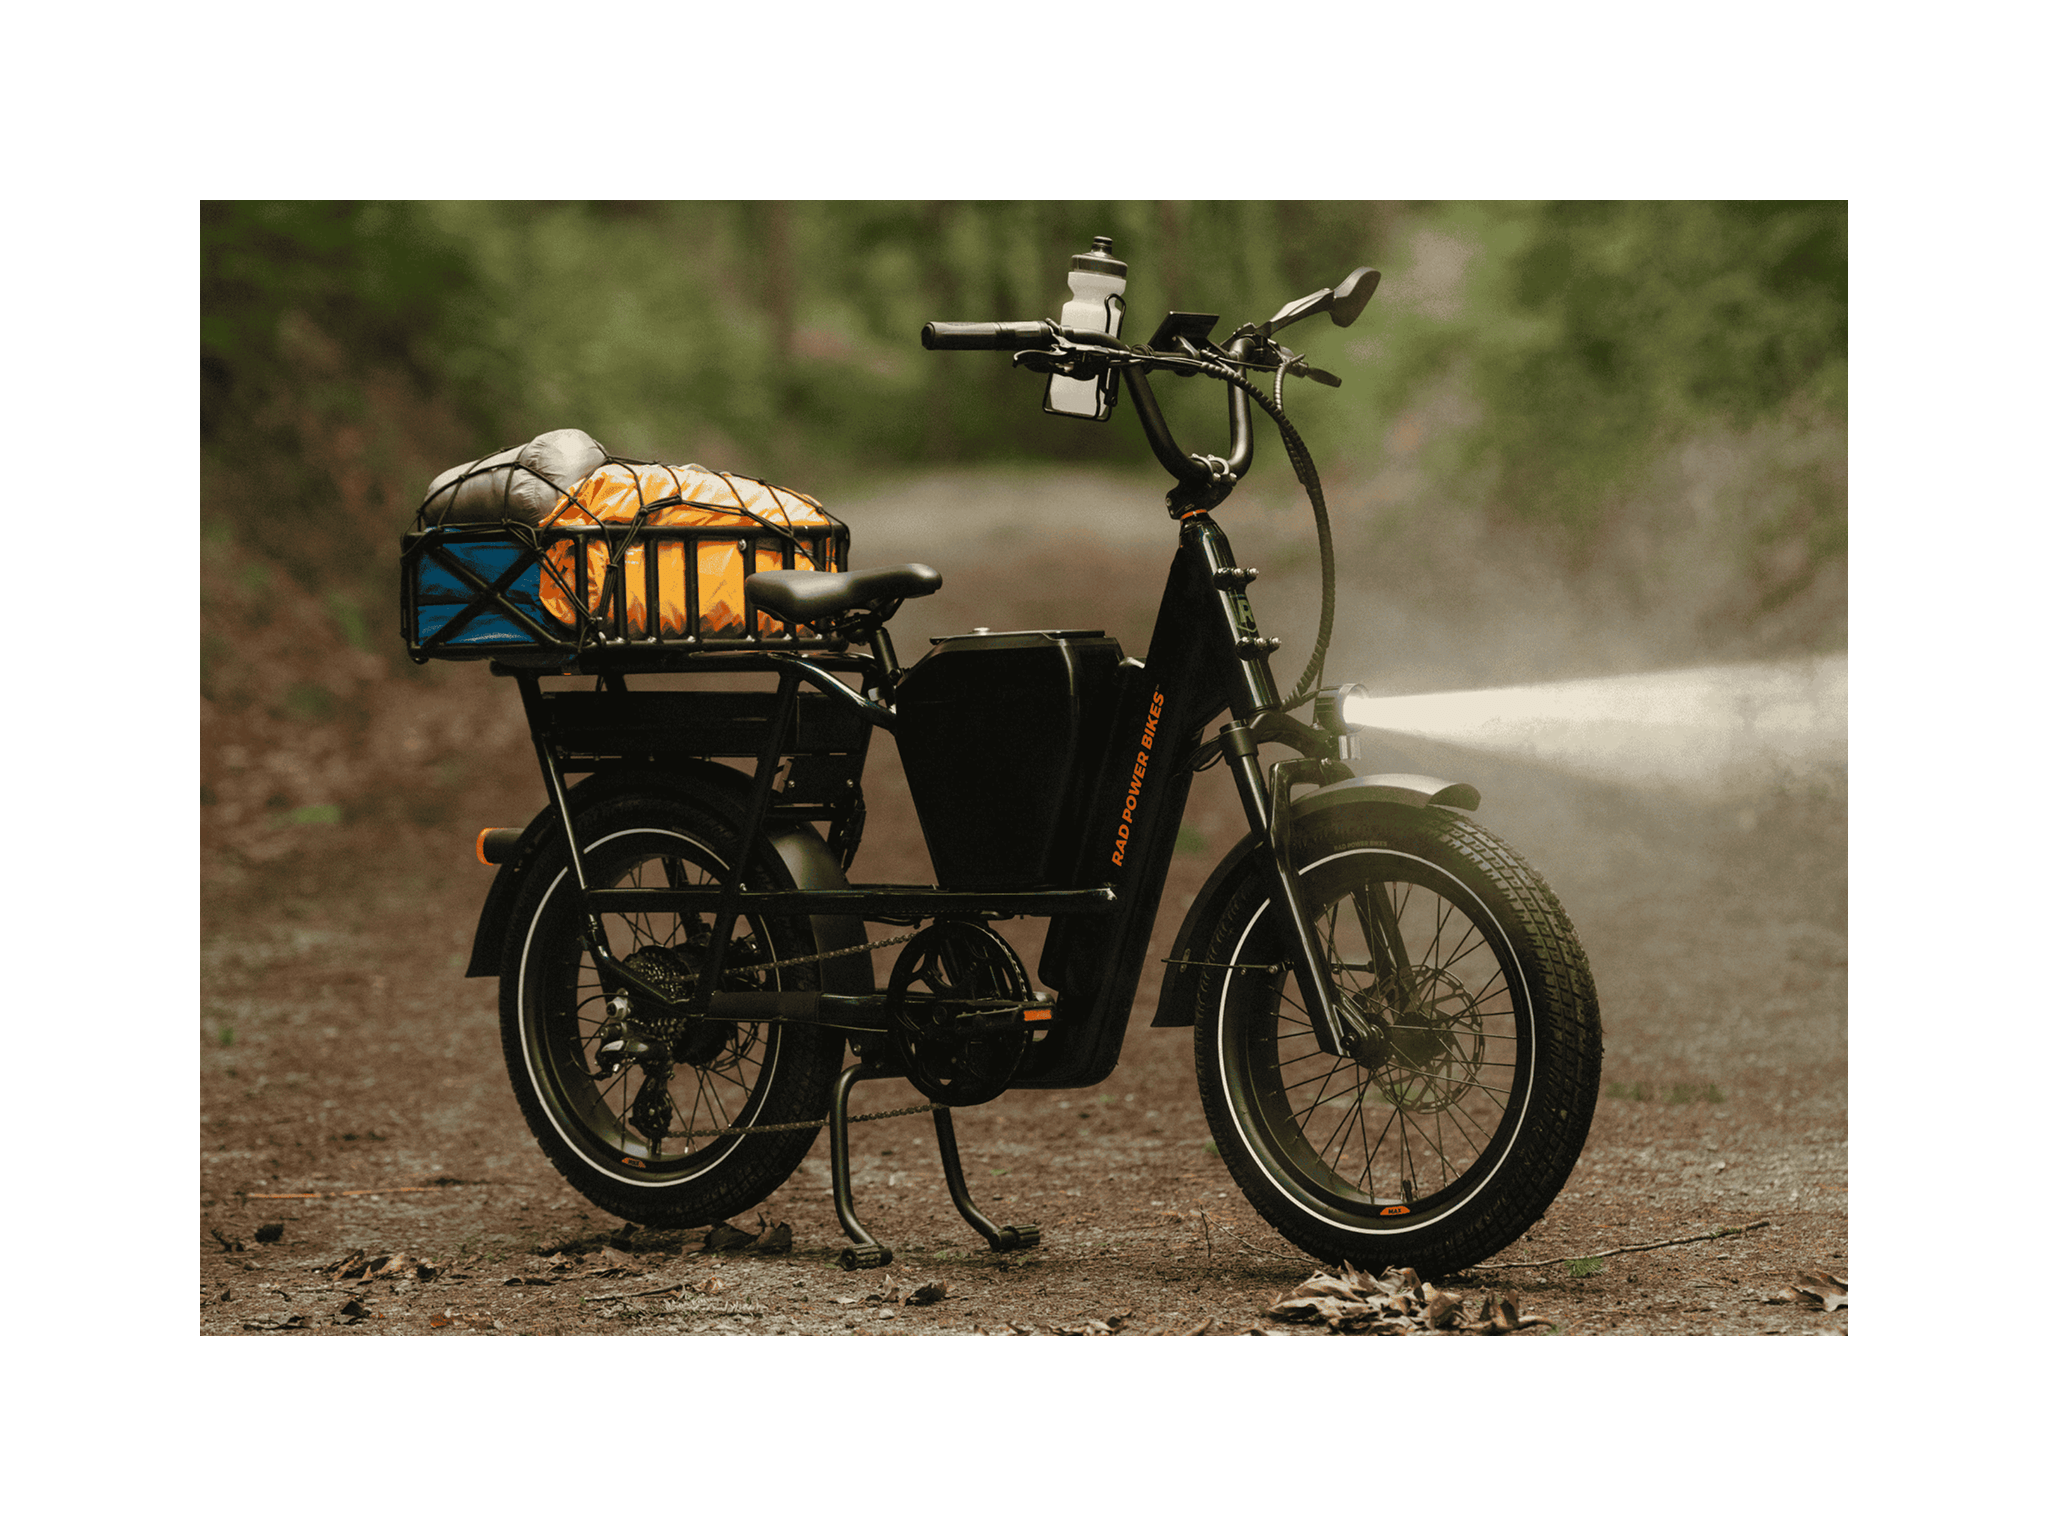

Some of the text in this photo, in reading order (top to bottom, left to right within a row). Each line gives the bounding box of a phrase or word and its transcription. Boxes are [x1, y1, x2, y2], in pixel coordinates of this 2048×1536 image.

[1112, 691, 1164, 867] RAD POWER BIKES
